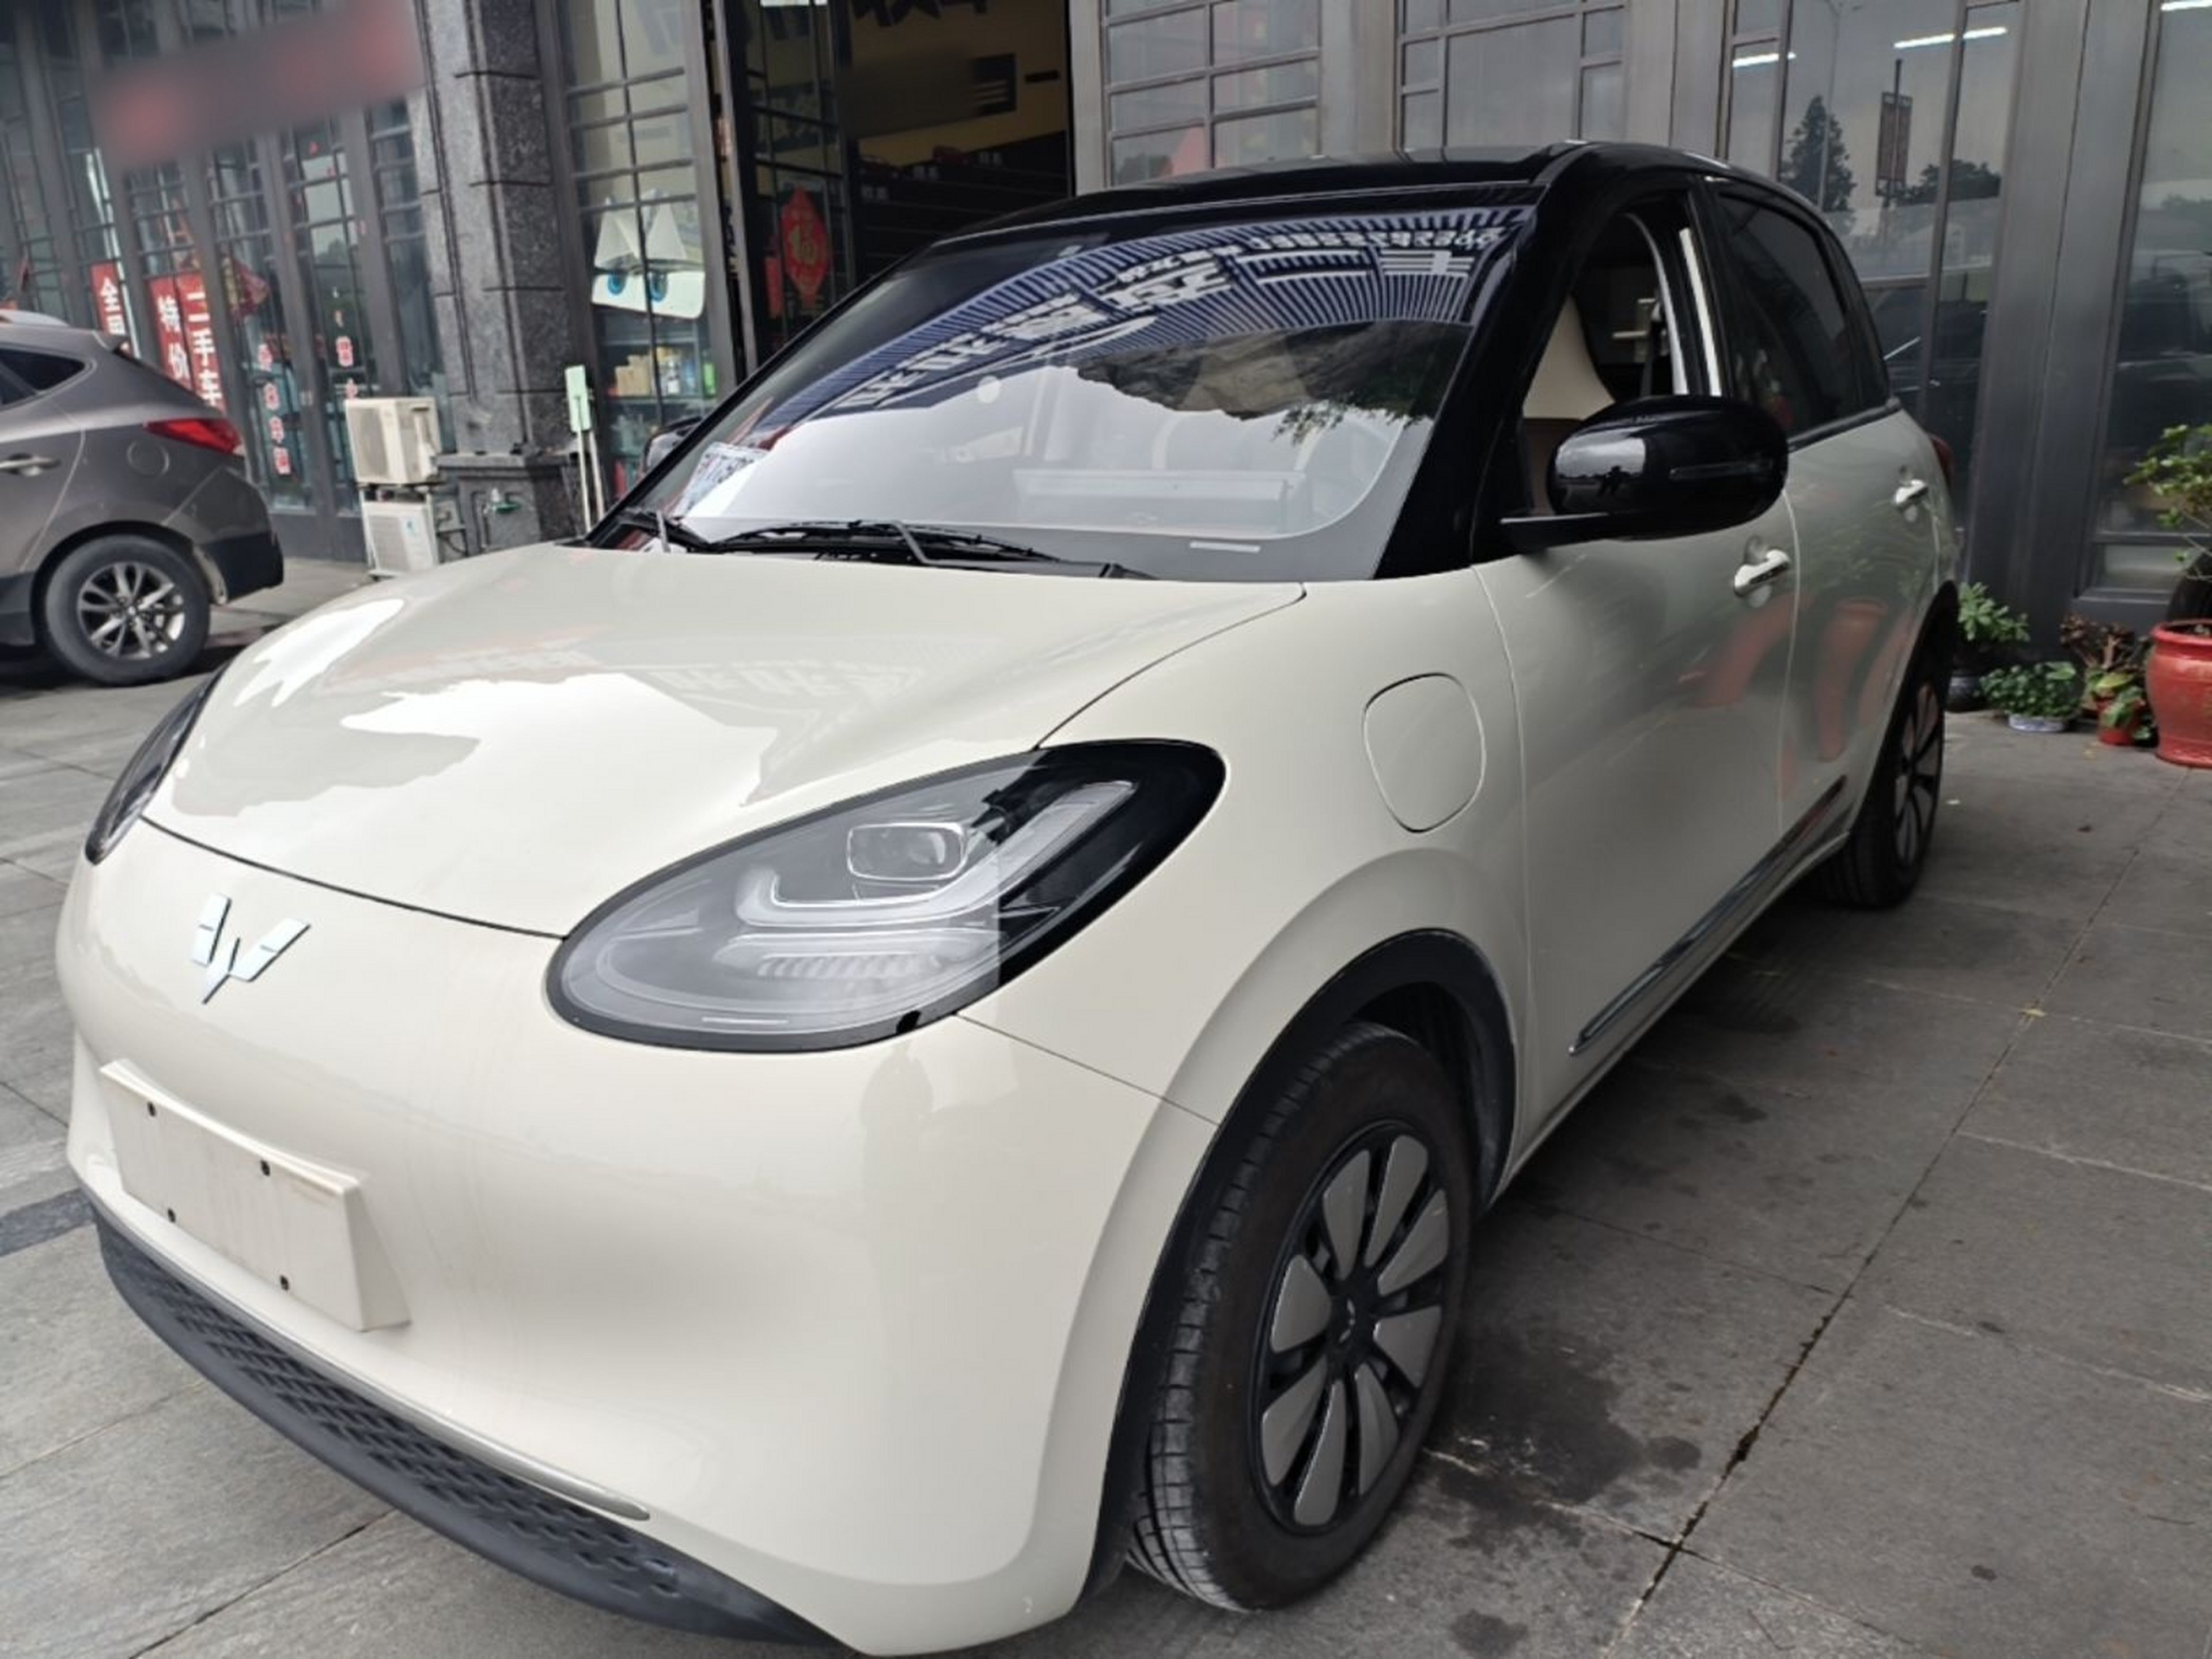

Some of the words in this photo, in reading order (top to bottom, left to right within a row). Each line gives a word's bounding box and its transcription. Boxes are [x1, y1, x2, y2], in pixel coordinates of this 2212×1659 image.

[157, 294, 191, 381] 特价
[186, 291, 224, 407] 二手车
